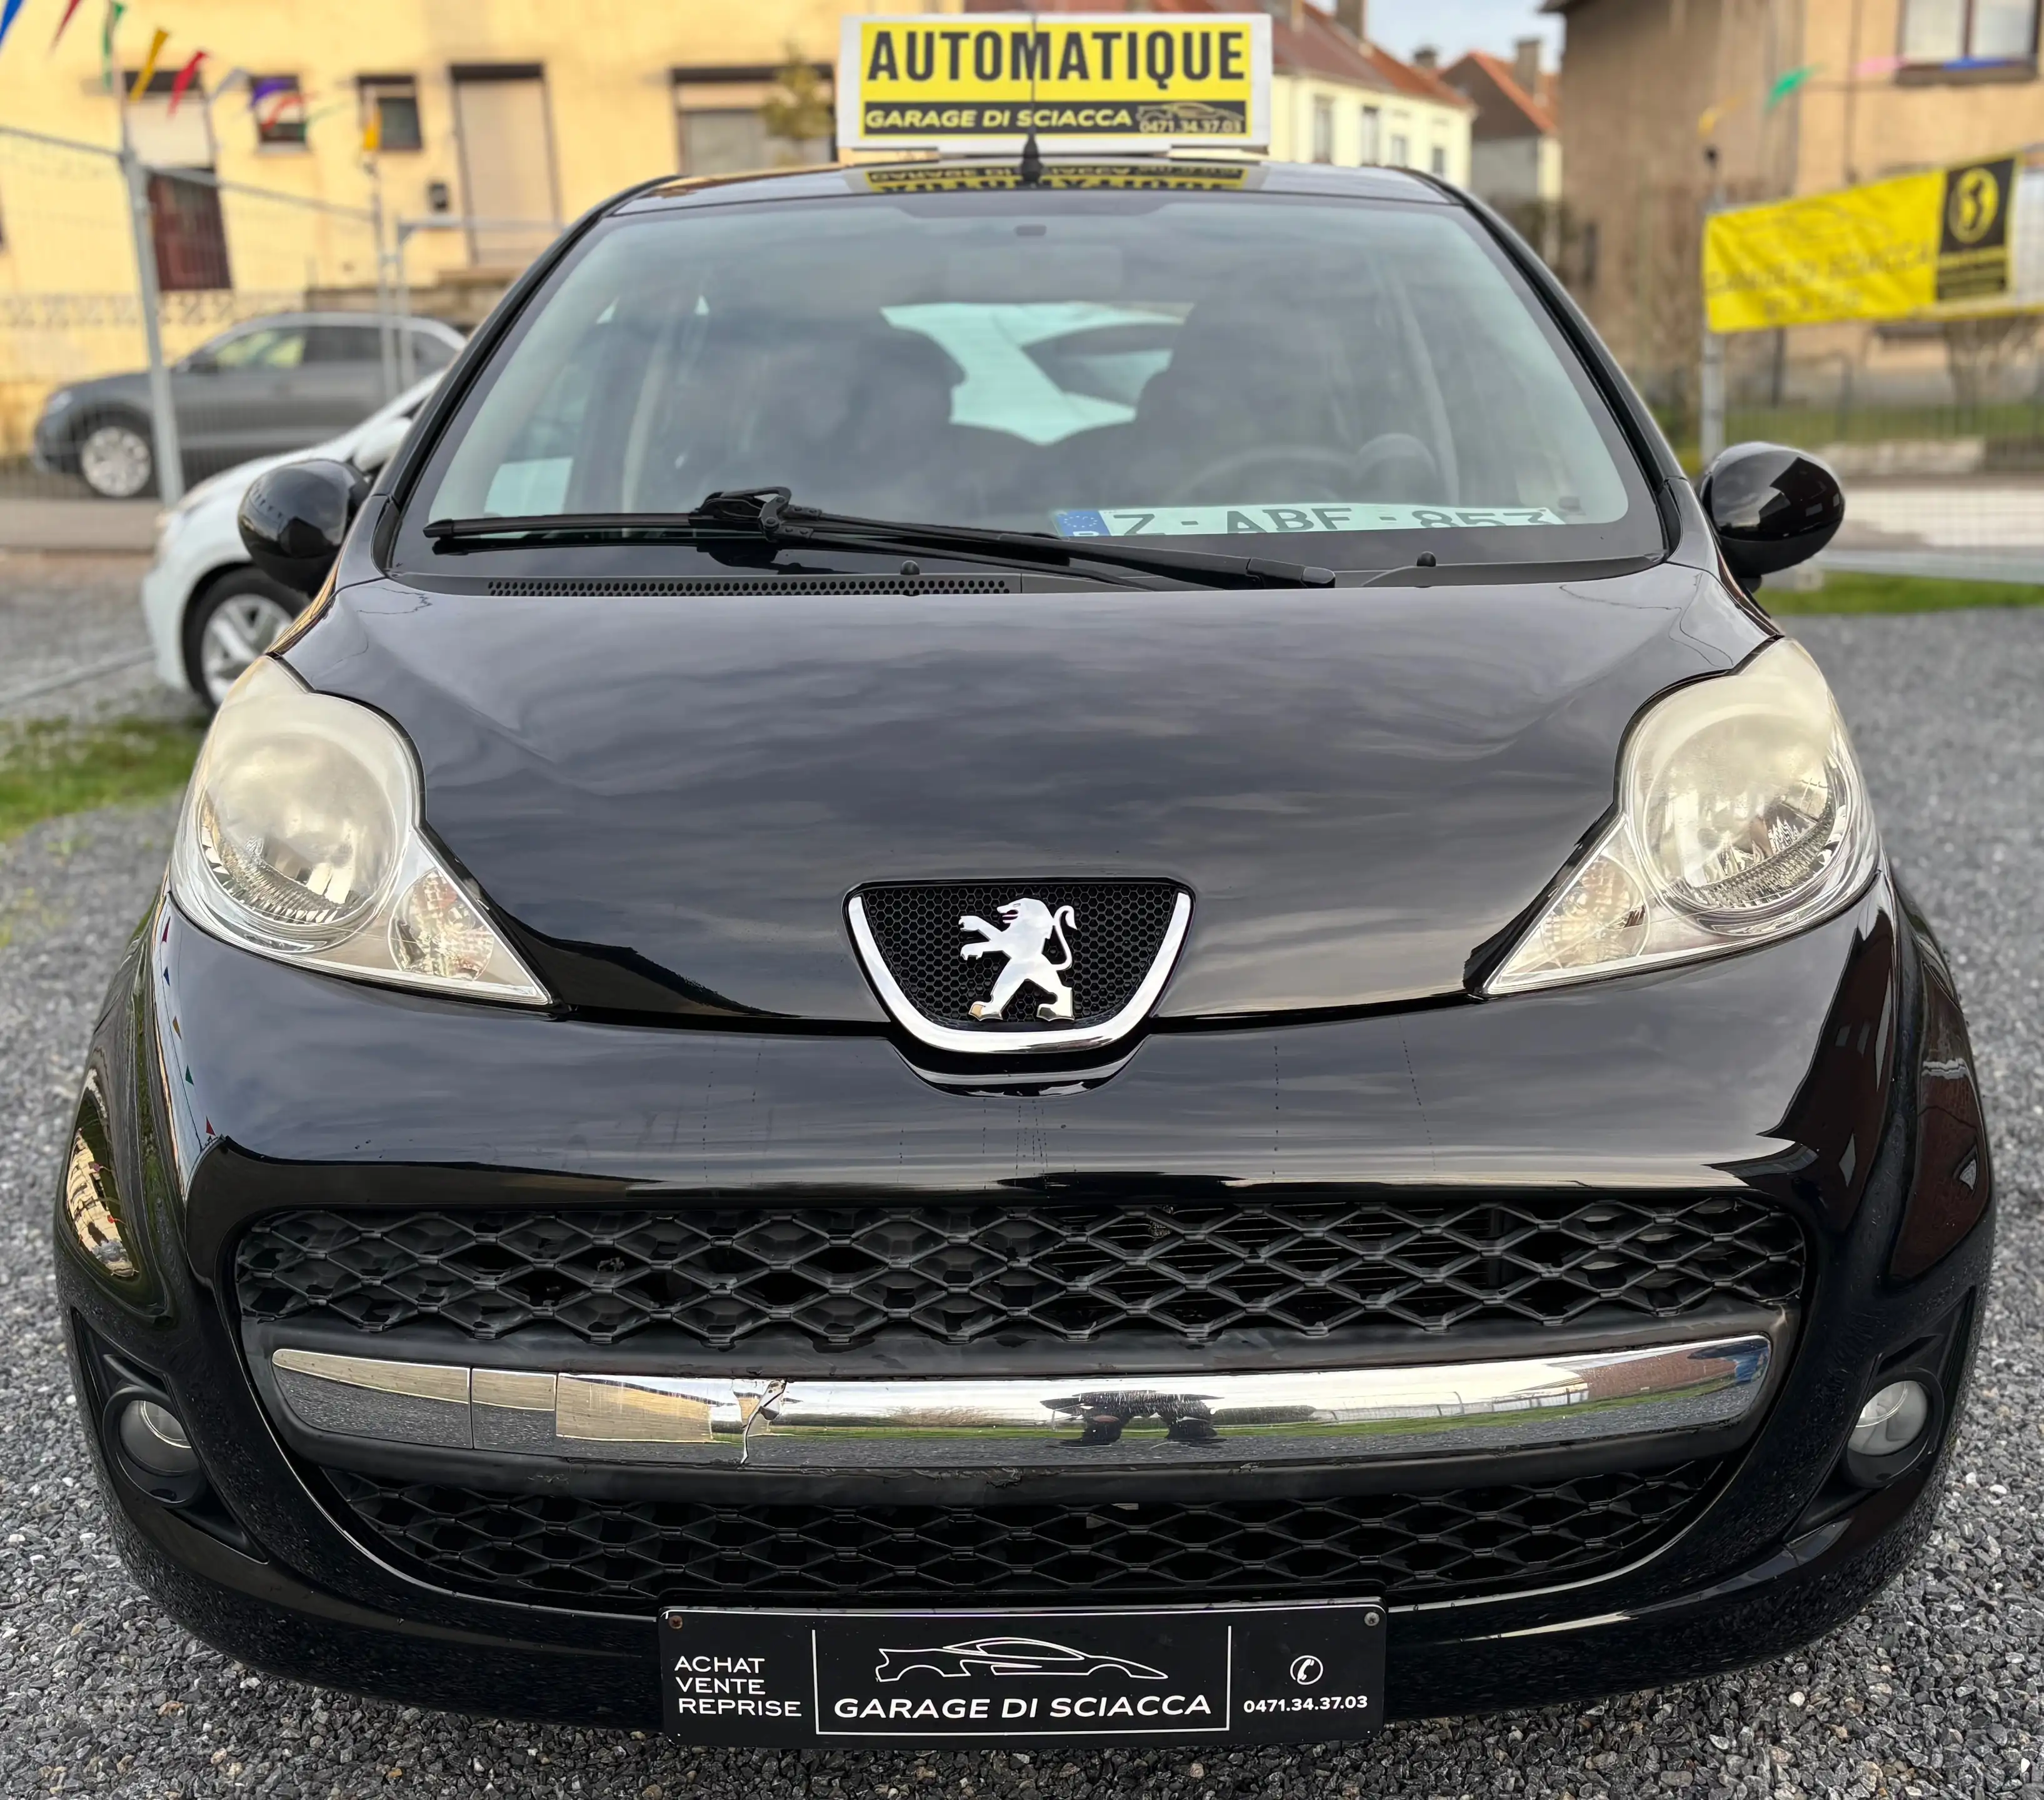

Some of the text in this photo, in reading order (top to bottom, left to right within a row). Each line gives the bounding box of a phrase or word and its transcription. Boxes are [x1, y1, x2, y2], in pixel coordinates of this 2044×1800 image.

[867, 31, 1245, 89] AUTOMATIQUE
[866, 109, 977, 128] GARAGE
[982, 109, 1010, 128] DI
[1016, 109, 1132, 128] SCIACCA
[674, 1656, 765, 1674] ACHAT
[675, 1676, 766, 1695] VENTE
[678, 1698, 802, 1717] REPRISE
[834, 1694, 1211, 1719] GARAGE DI SCIACCA
[1243, 1696, 1368, 1713] 0471.34.37.03
